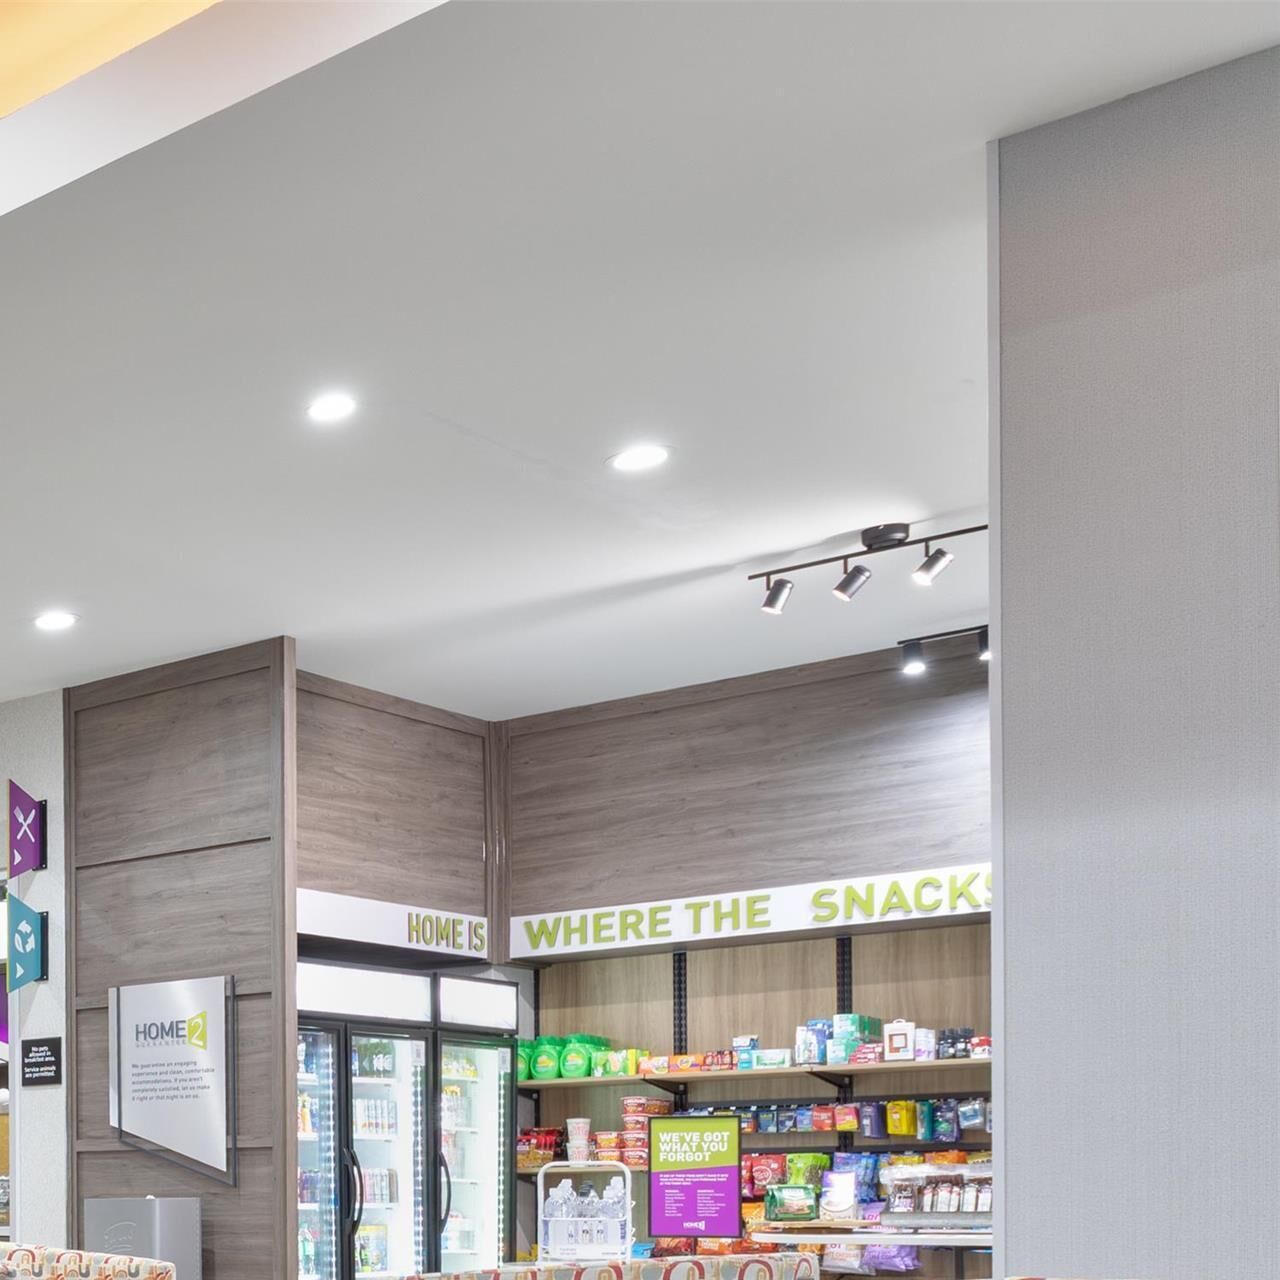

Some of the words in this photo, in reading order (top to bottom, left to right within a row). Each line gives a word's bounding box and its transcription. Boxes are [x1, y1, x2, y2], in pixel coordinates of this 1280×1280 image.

[523, 905, 672, 950] WHERE
[684, 894, 771, 934] THE
[811, 872, 992, 923] SNACK
[407, 911, 464, 949] HOME
[468, 920, 486, 953] IS
[659, 1131, 701, 1142] WE'VE
[703, 1131, 730, 1142] GOT
[659, 1142, 699, 1152] WHAT
[701, 1141, 728, 1152] YOU
[659, 1151, 711, 1162] FORGOT
